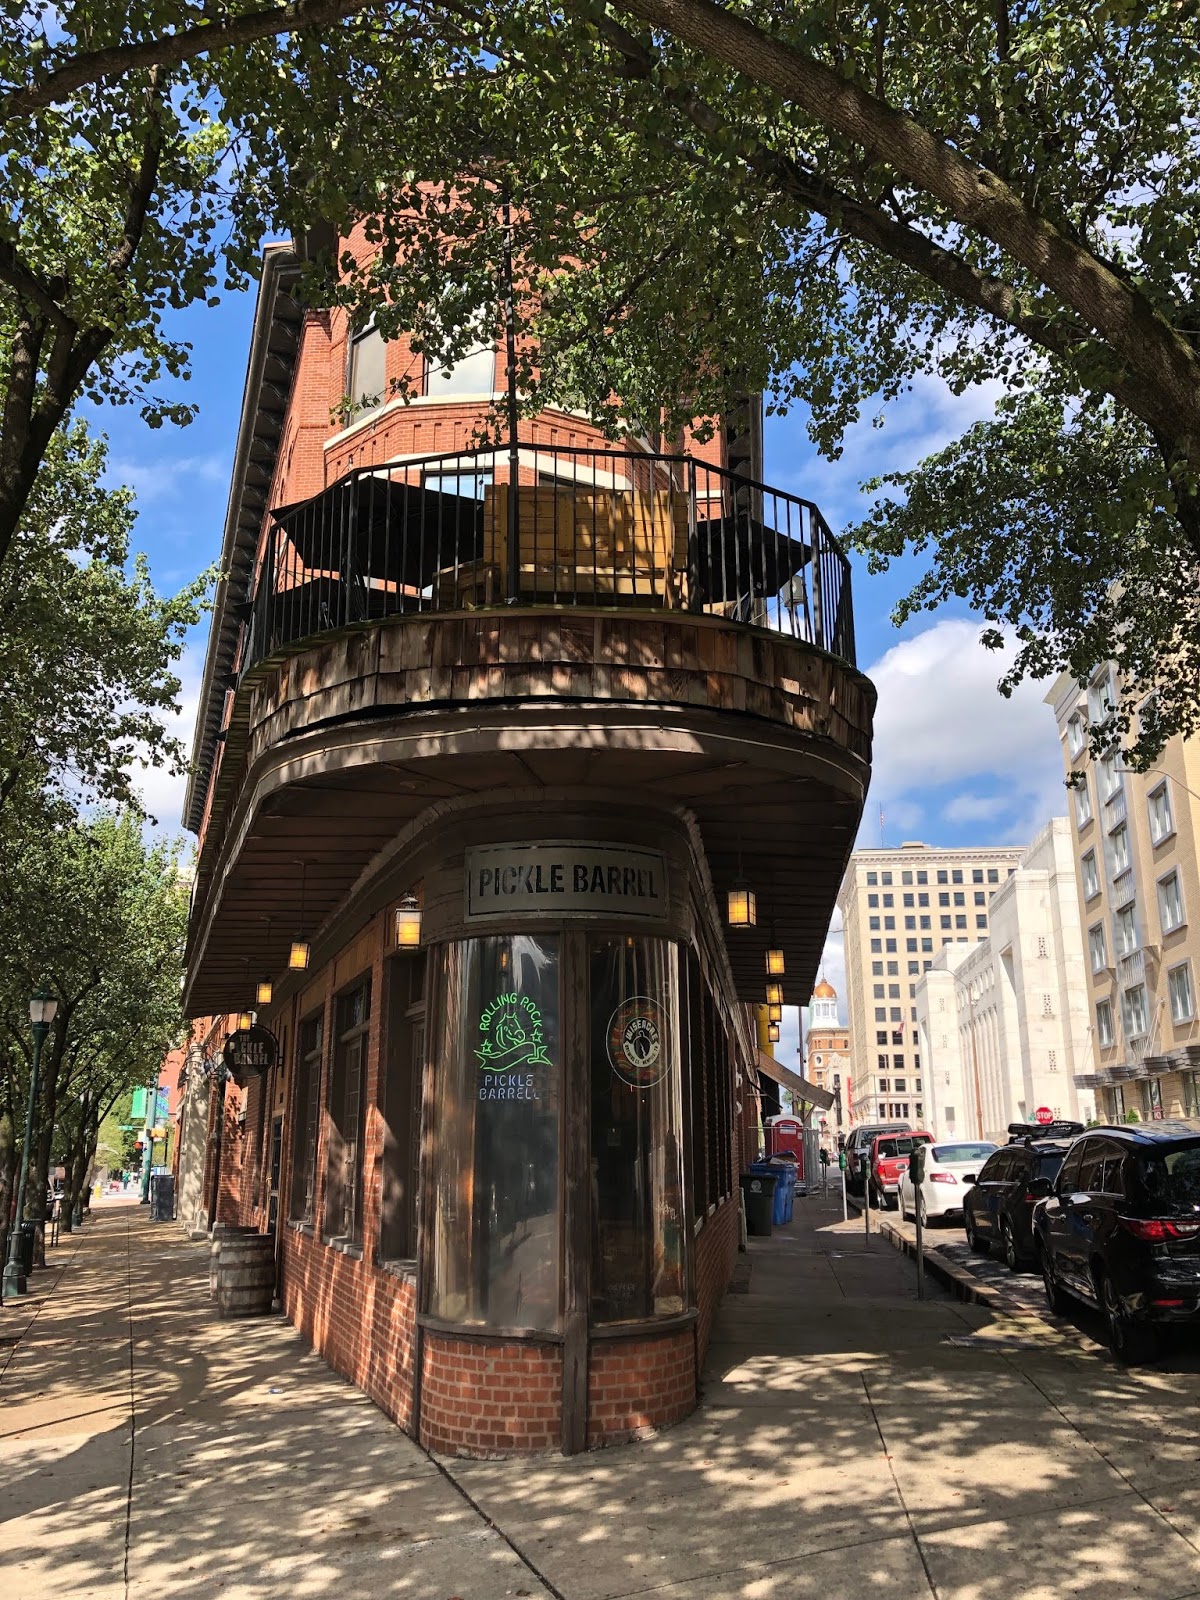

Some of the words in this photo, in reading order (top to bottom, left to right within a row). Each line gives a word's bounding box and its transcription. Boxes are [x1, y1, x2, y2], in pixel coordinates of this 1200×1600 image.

[479, 864, 565, 897] PICKLE
[573, 864, 658, 899] BARREL
[480, 992, 518, 1031] ROLLING
[520, 996, 543, 1028] ROCK
[625, 1019, 659, 1041] WISEACRE
[229, 1041, 264, 1054] PCKLE
[485, 1074, 534, 1087] PICKLE
[1036, 1111, 1053, 1120] STOP
